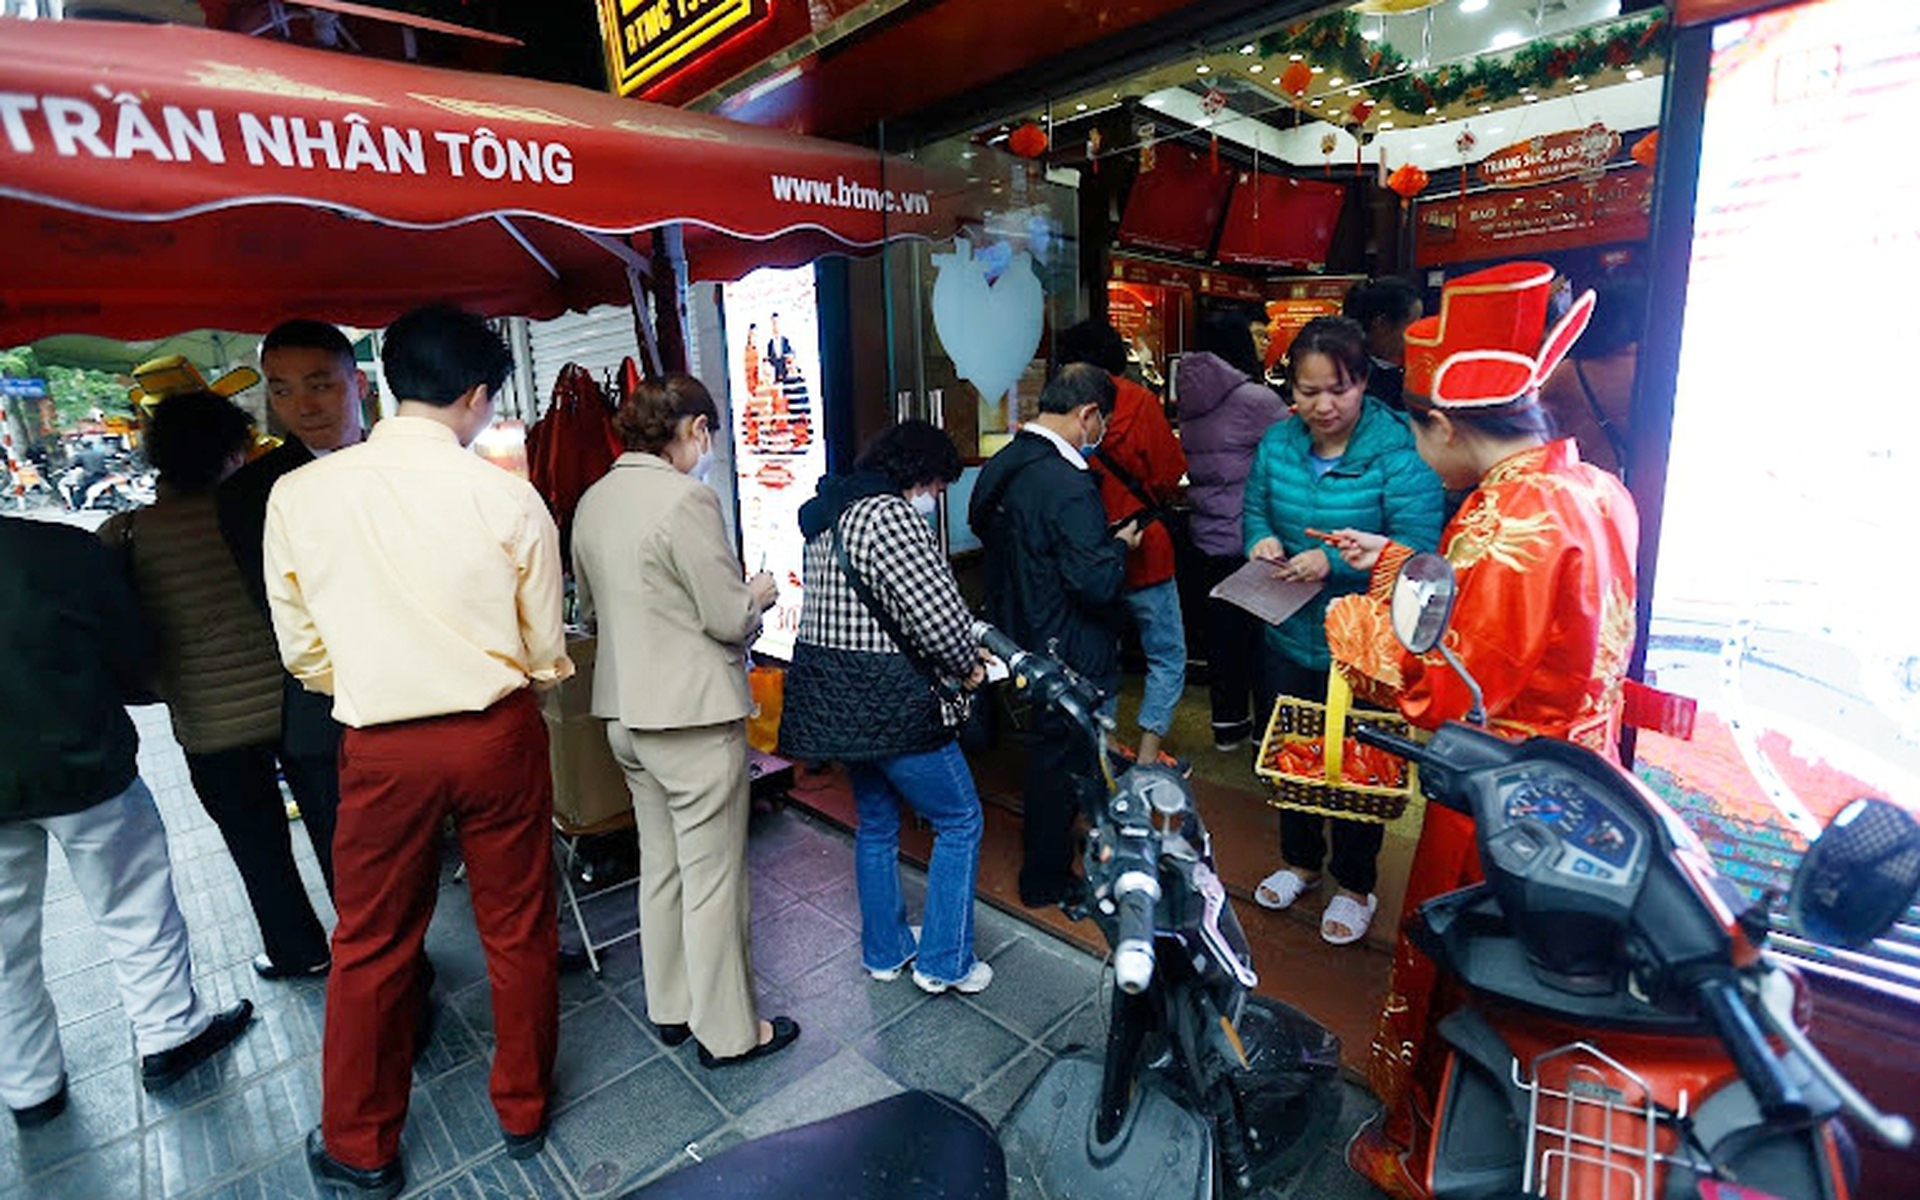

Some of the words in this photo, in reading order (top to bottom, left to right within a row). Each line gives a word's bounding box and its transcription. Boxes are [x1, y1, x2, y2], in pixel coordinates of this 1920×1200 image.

[0, 84, 225, 164] TRẦN
[238, 112, 427, 175] NHÂN
[435, 127, 573, 184] TÔNG
[771, 175, 929, 214] www.btmc.vn
